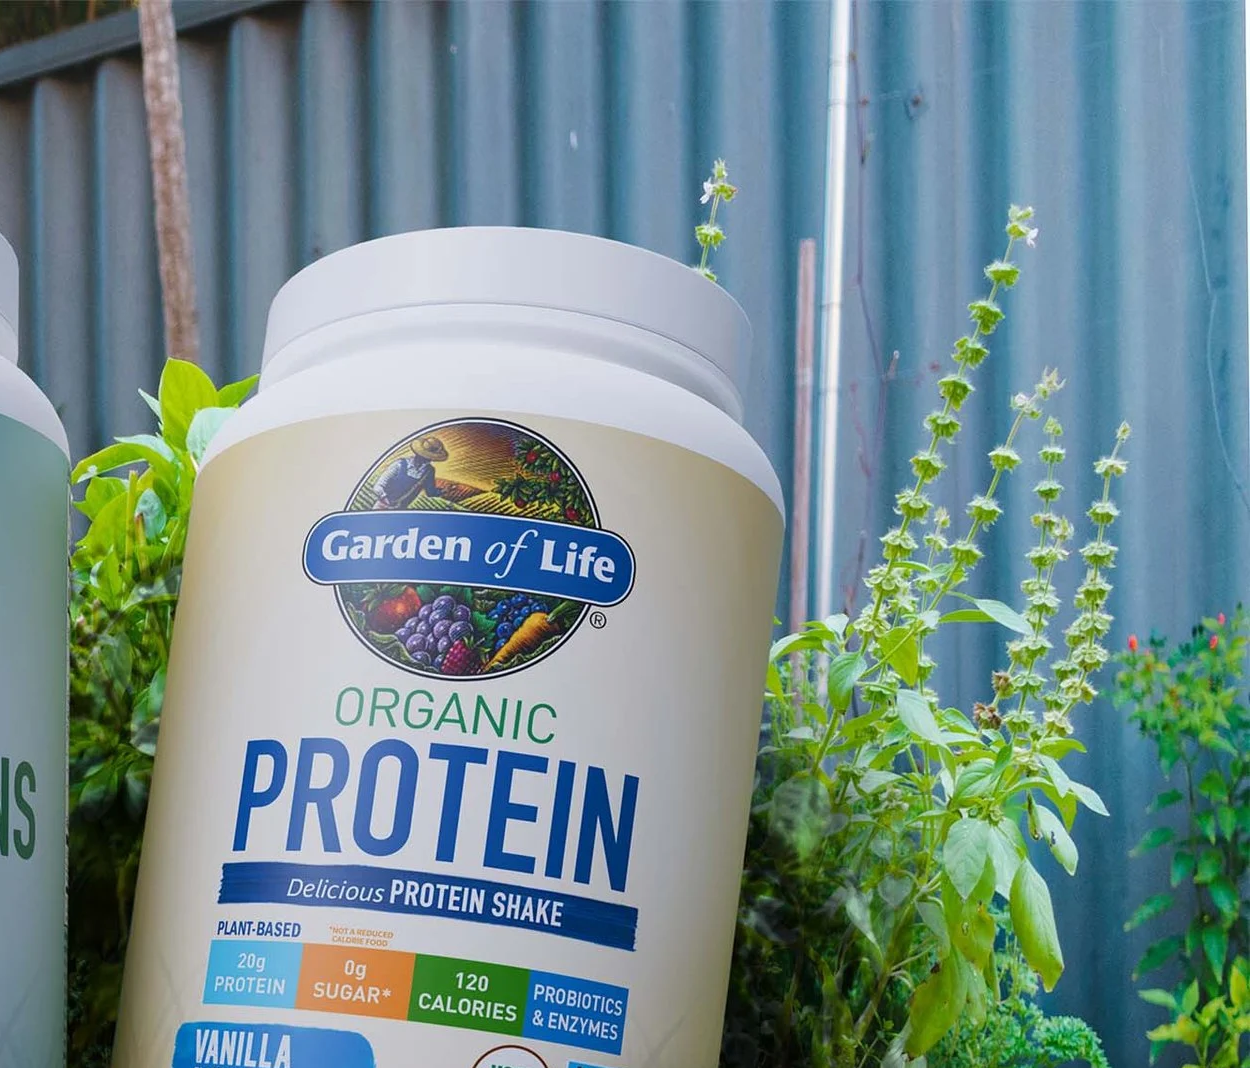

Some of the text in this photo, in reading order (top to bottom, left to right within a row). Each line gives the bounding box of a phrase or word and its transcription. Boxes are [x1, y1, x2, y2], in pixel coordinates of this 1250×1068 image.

[322, 528, 616, 584] Garden of Life
[335, 686, 558, 744] ORGANIC
[232, 737, 639, 892] PROTEIN
[286, 878, 564, 927] Delicious PROTEIN SHAKE
[217, 921, 301, 938] PLANT-BASED
[237, 953, 266, 973] 20g
[344, 960, 366, 981] 0g
[214, 976, 286, 995] PROTEIN
[455, 972, 489, 992] 120
[418, 993, 517, 1022] CALORIES
[534, 984, 623, 1017] PROBIOTICS
[532, 1010, 618, 1040] & ENZYMES
